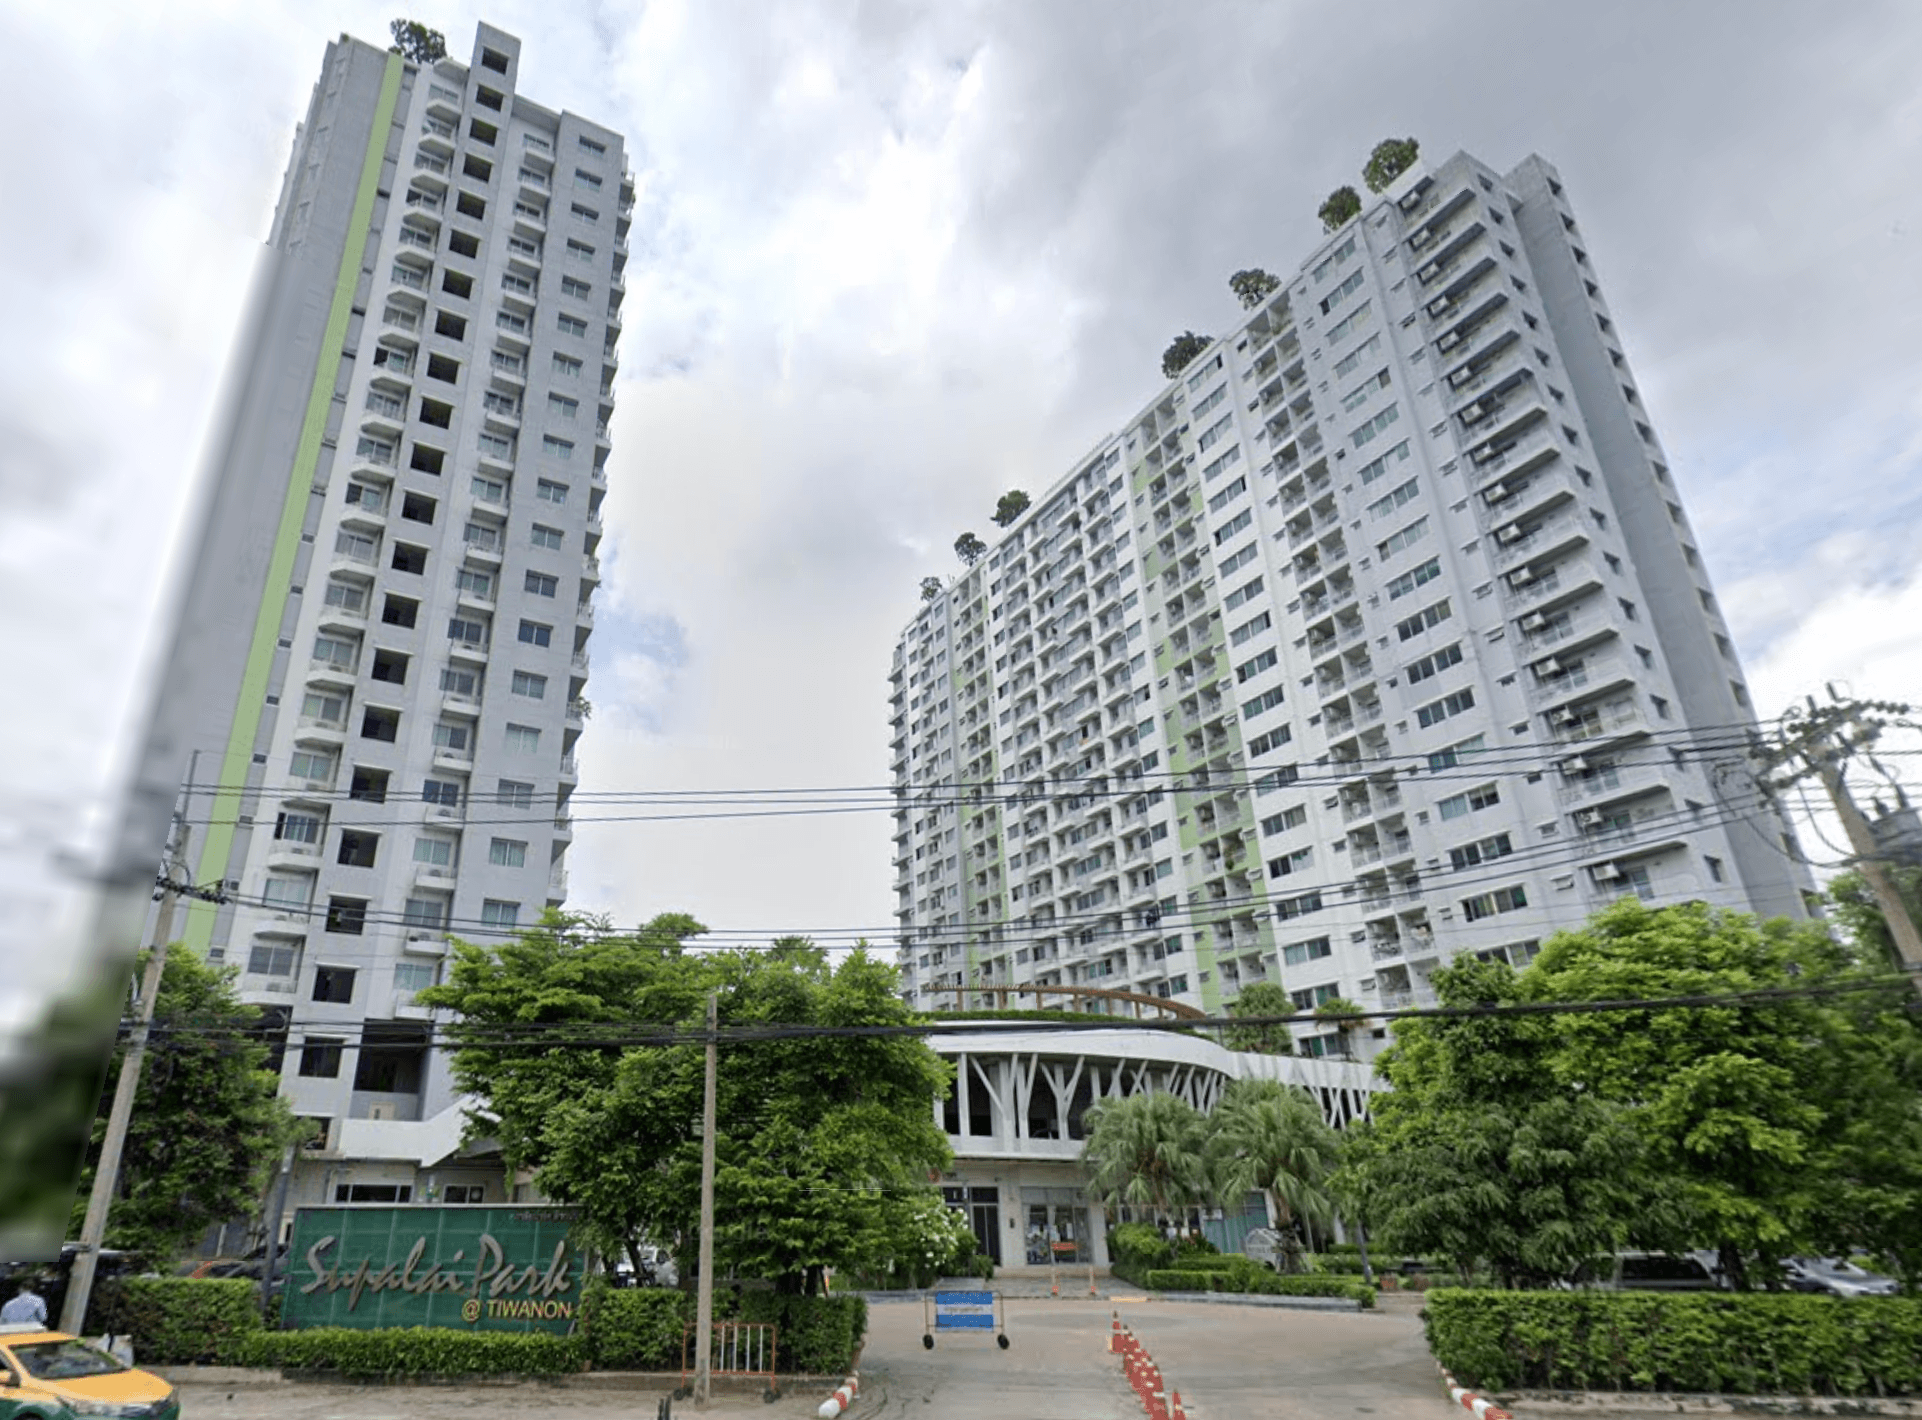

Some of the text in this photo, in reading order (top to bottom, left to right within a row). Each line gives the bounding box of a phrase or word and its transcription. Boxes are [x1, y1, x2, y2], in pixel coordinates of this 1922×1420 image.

[300, 1233, 571, 1311] Supalai Park
[461, 1299, 573, 1322] @ TIWANON
